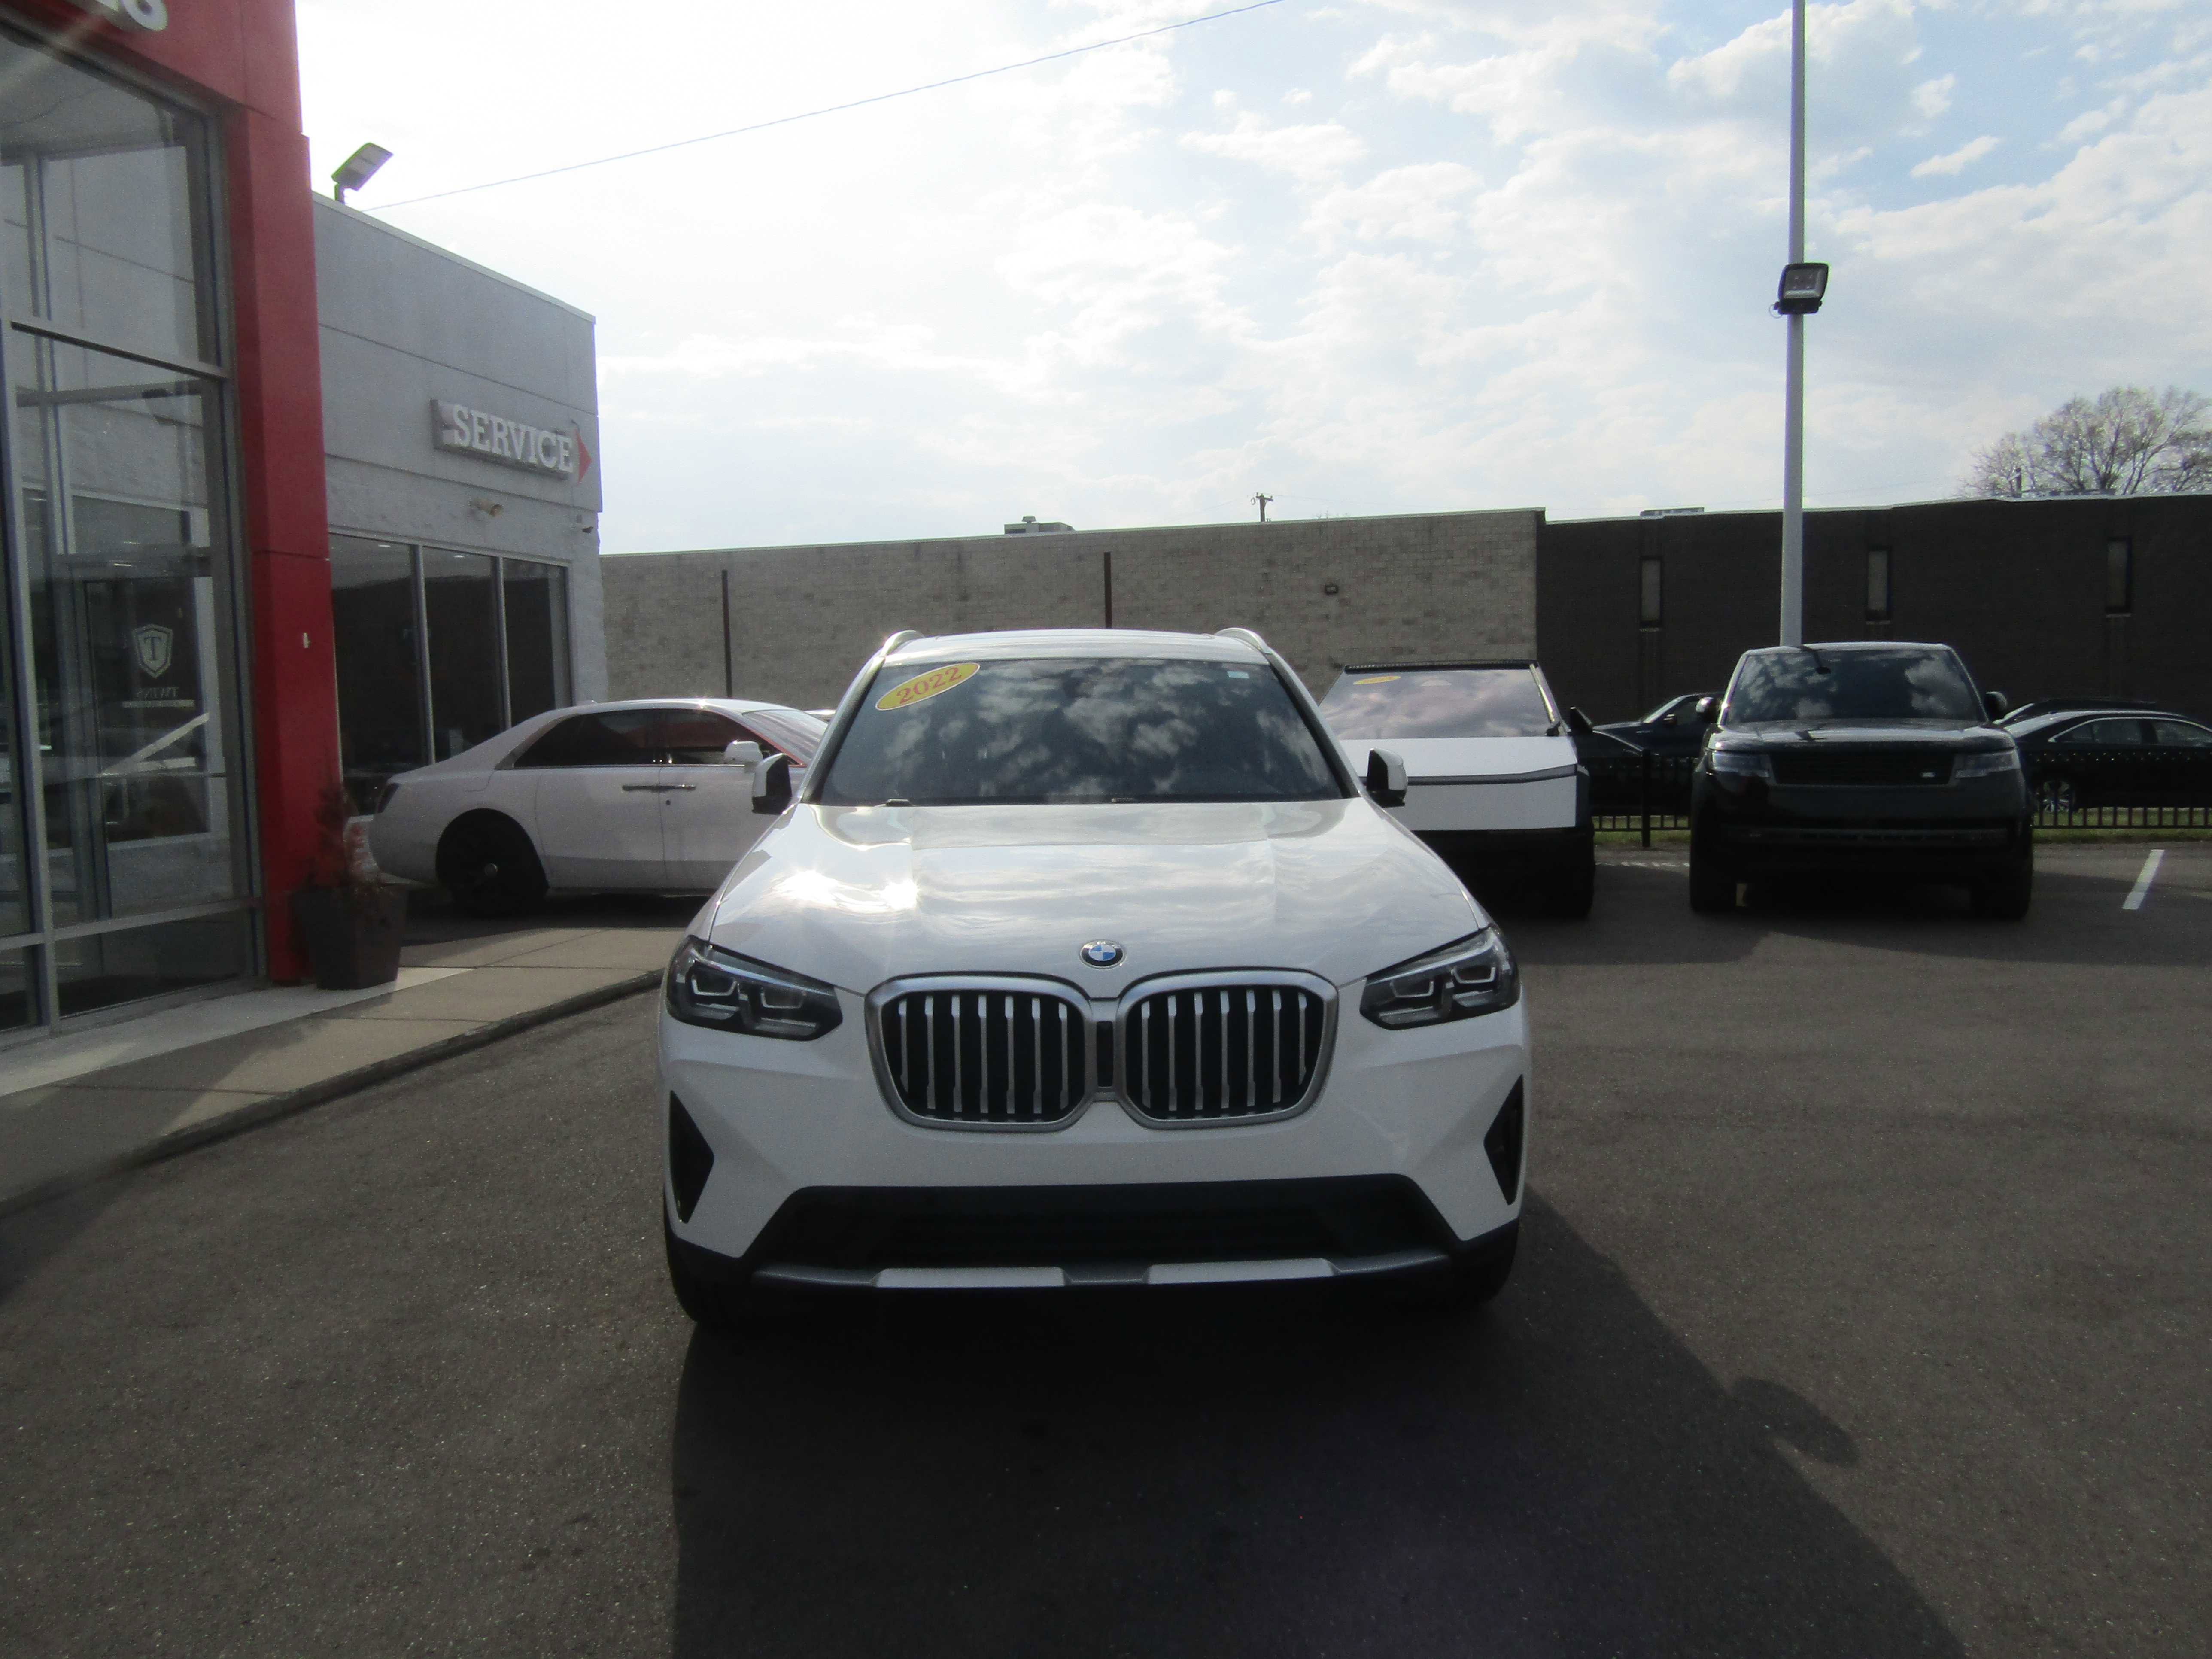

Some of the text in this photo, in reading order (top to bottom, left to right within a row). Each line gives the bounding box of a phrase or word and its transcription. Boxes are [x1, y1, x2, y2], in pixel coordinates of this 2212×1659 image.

[453, 404, 574, 473] SERVICE
[143, 635, 163, 661] T
[896, 667, 962, 704] 2022
